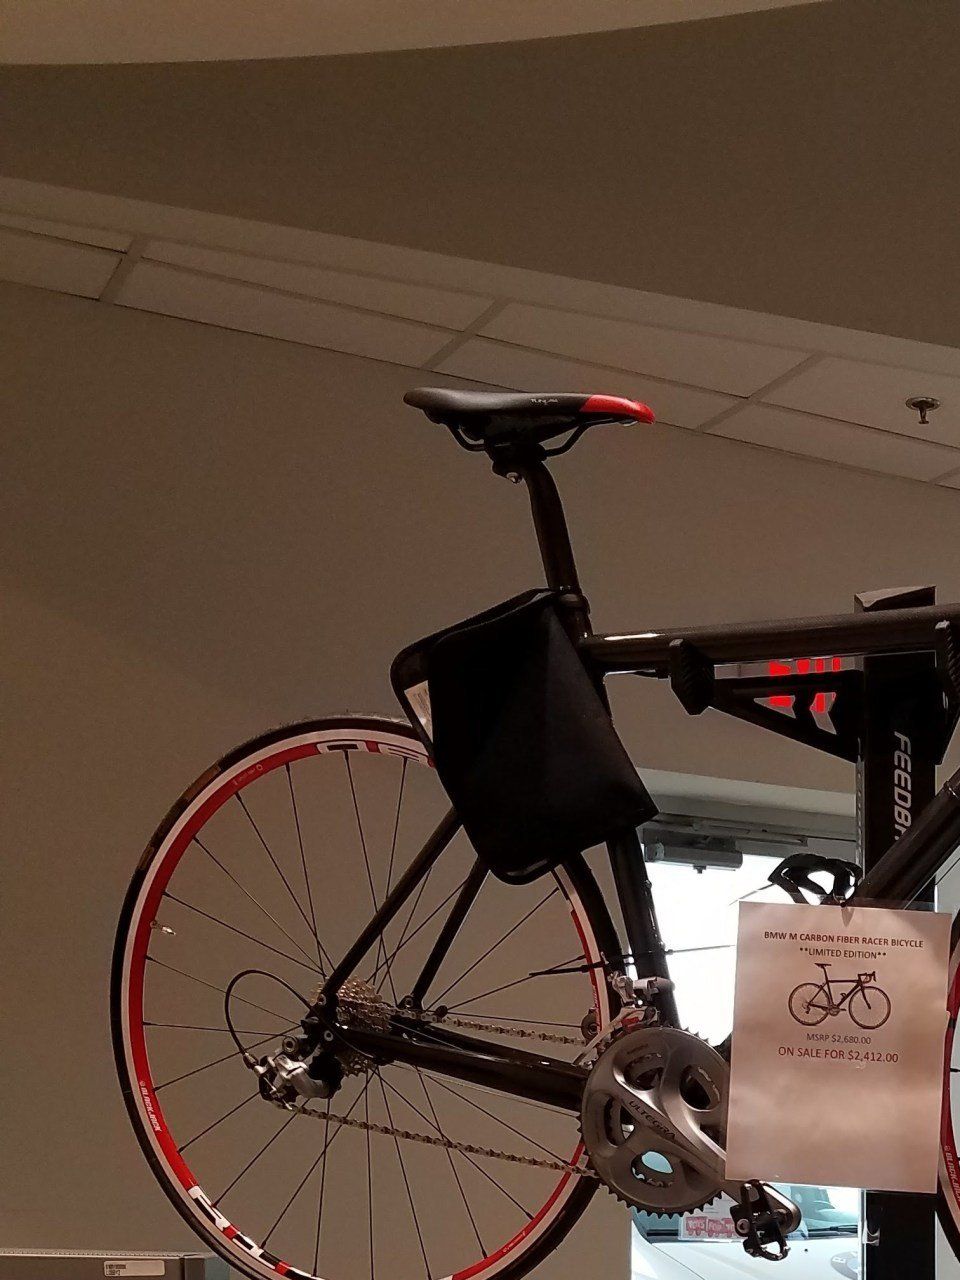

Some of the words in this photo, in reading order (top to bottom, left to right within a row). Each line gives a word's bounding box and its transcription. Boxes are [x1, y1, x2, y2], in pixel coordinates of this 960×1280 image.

[764, 931, 787, 940] BMW
[789, 932, 798, 941] M
[800, 933, 835, 943] CARBON
[837, 935, 860, 944] FIBER
[862, 937, 889, 946] RACER
[891, 938, 924, 948] BICYCLE
[806, 1033, 830, 1042] MSRP
[778, 1046, 795, 1056] ON
[797, 1047, 822, 1058] SALE
[824, 1049, 846, 1060] FOR
[848, 1050, 899, 1063] $2,412.00
[629, 1100, 678, 1140] ULTEGRA
